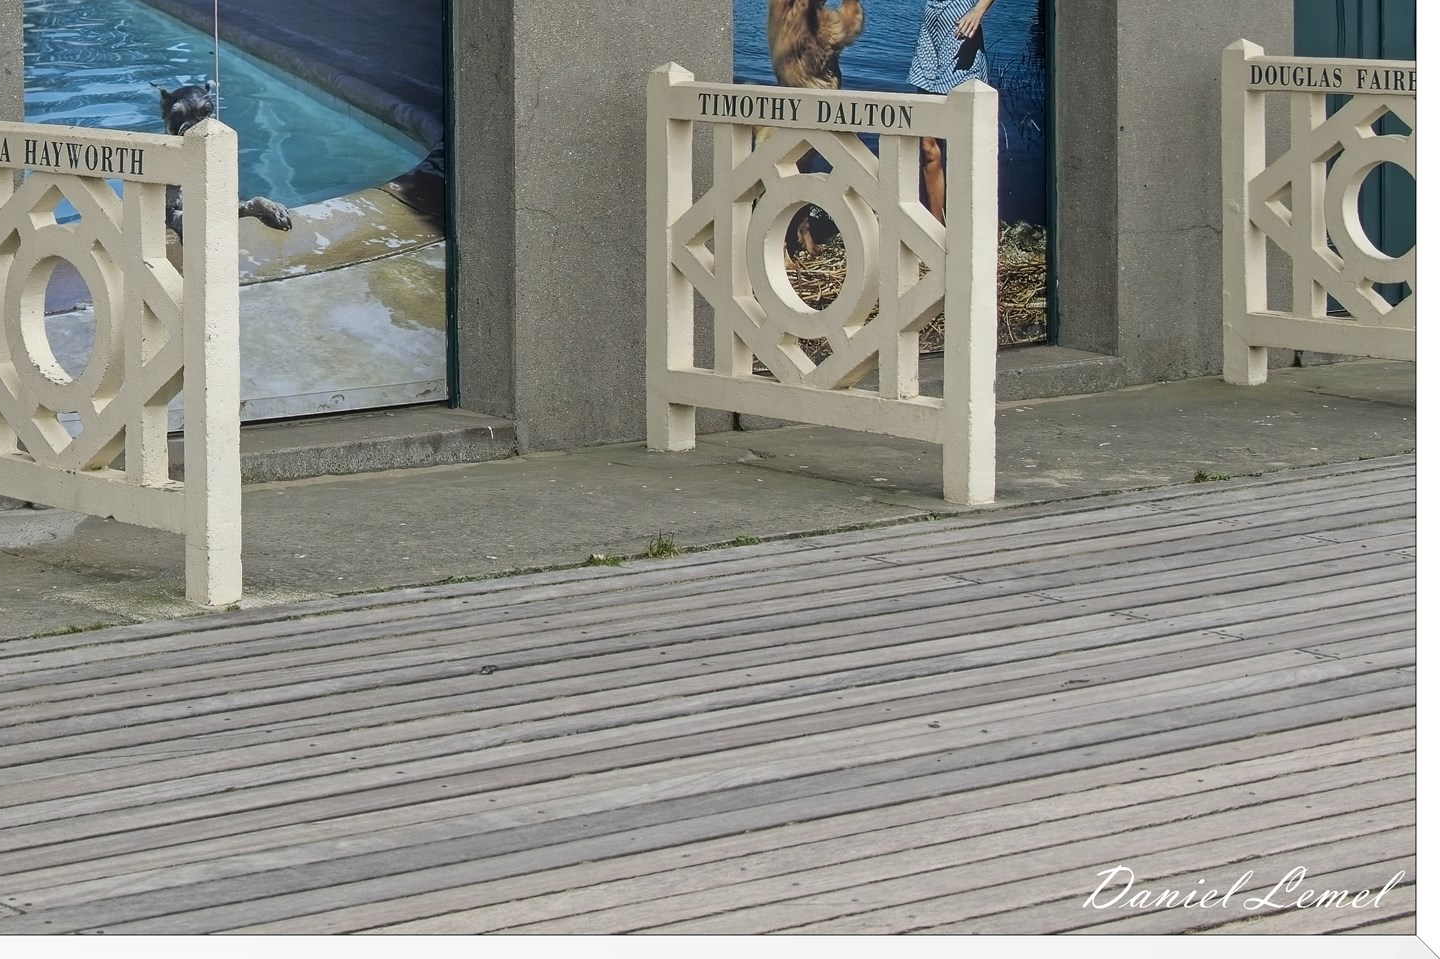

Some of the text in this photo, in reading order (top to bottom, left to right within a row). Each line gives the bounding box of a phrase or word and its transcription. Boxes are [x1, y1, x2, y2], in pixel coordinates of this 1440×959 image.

[1250, 65, 1343, 88] DOUGLAS
[698, 93, 914, 129] TIMOTHY DALTON
[24, 139, 145, 175] HAYWORTH
